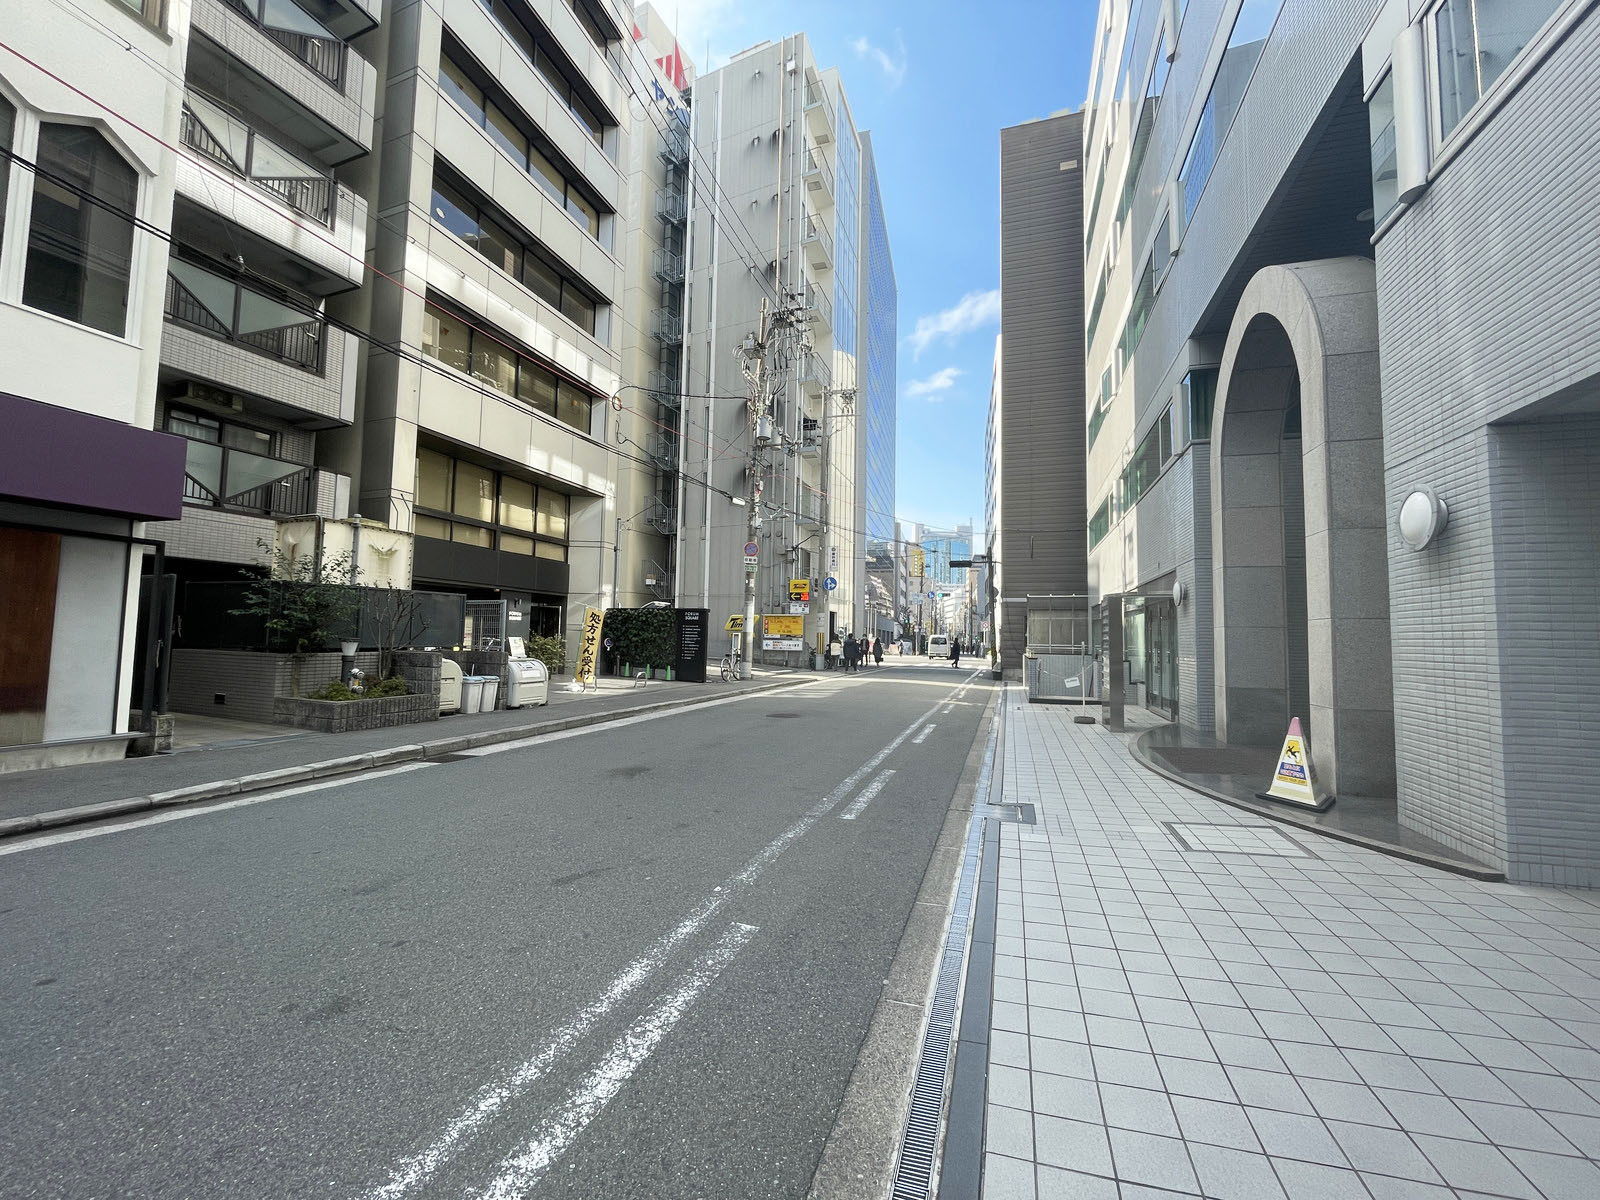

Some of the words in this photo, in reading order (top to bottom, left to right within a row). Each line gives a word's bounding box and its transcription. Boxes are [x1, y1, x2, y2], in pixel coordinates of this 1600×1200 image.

[578, 611, 601, 679] 処方せん受付
